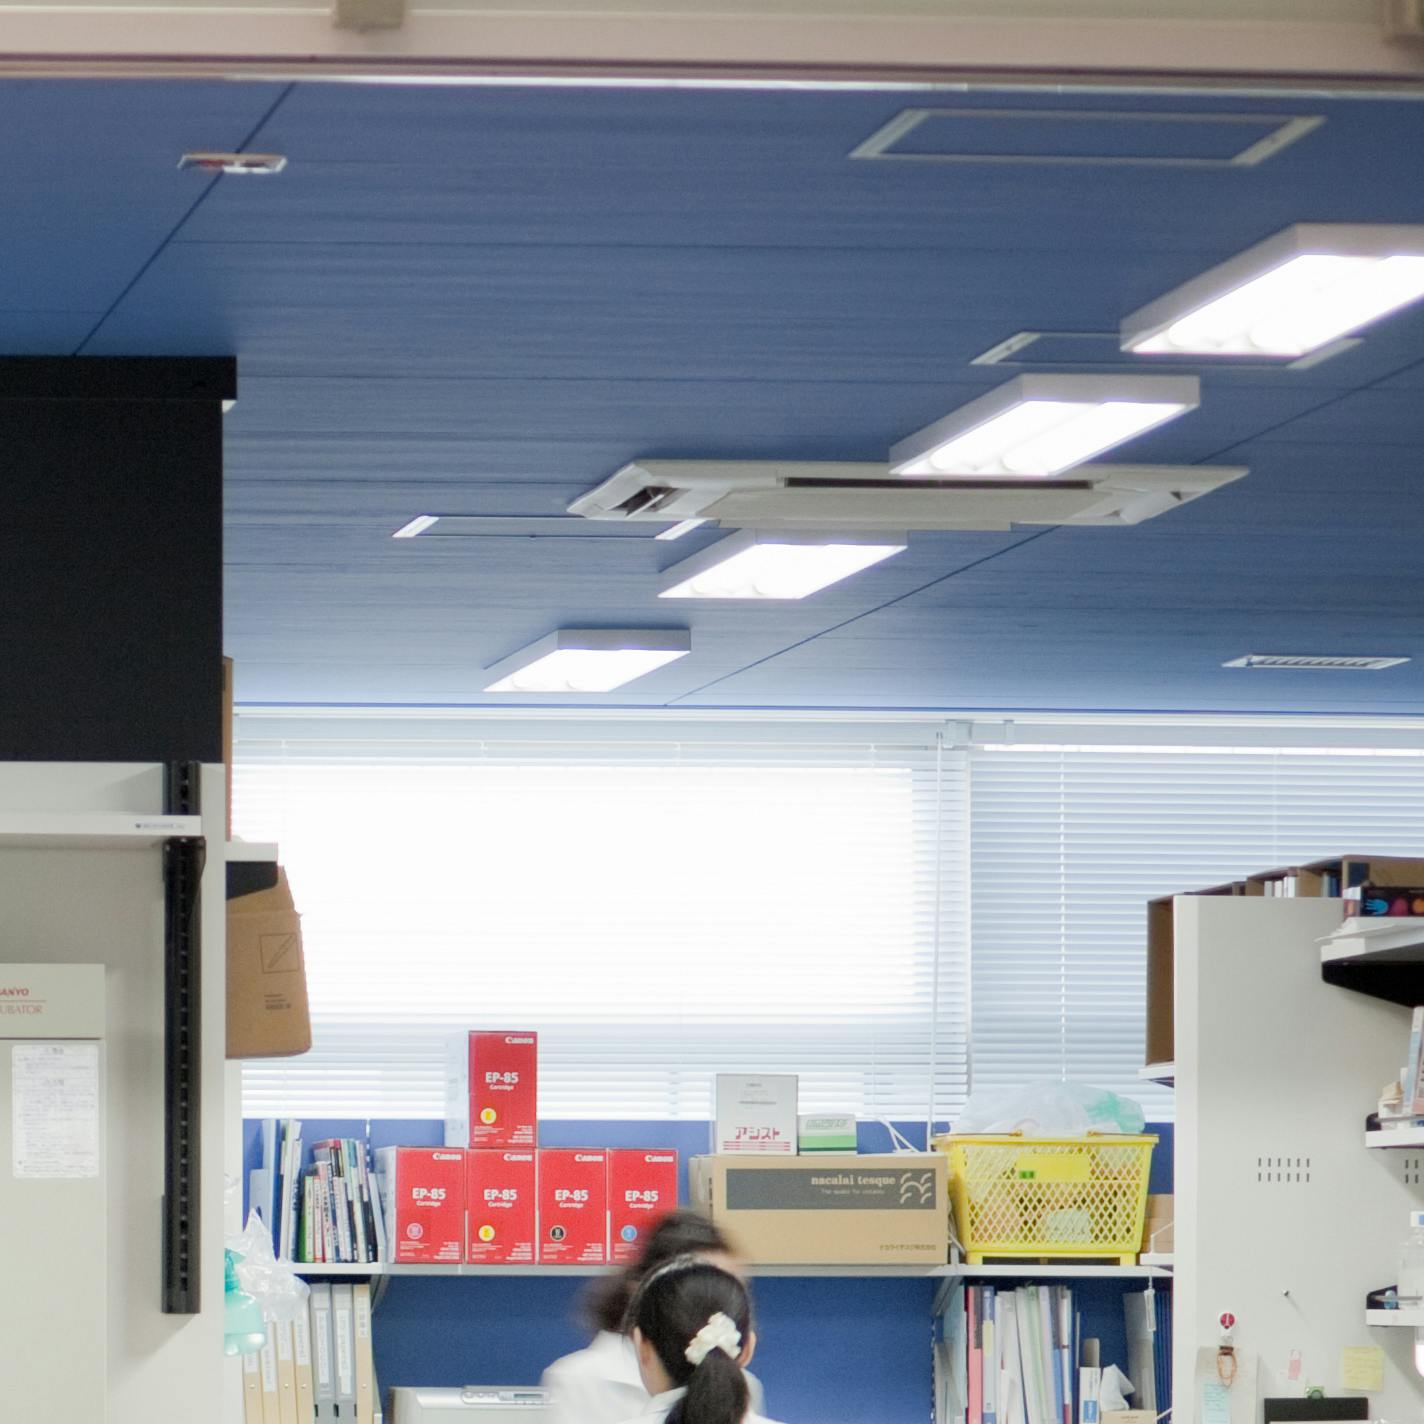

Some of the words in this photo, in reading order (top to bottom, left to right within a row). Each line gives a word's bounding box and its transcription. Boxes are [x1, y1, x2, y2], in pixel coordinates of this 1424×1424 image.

[485, 1072, 519, 1084] EP-85
[811, 1174, 854, 1185] nacalai
[857, 1175, 896, 1187] tesque
[412, 1187, 446, 1200] EP-85
[483, 1189, 518, 1201] EP-85
[554, 1190, 589, 1201] EP-85
[624, 1190, 659, 1202] EP-85
